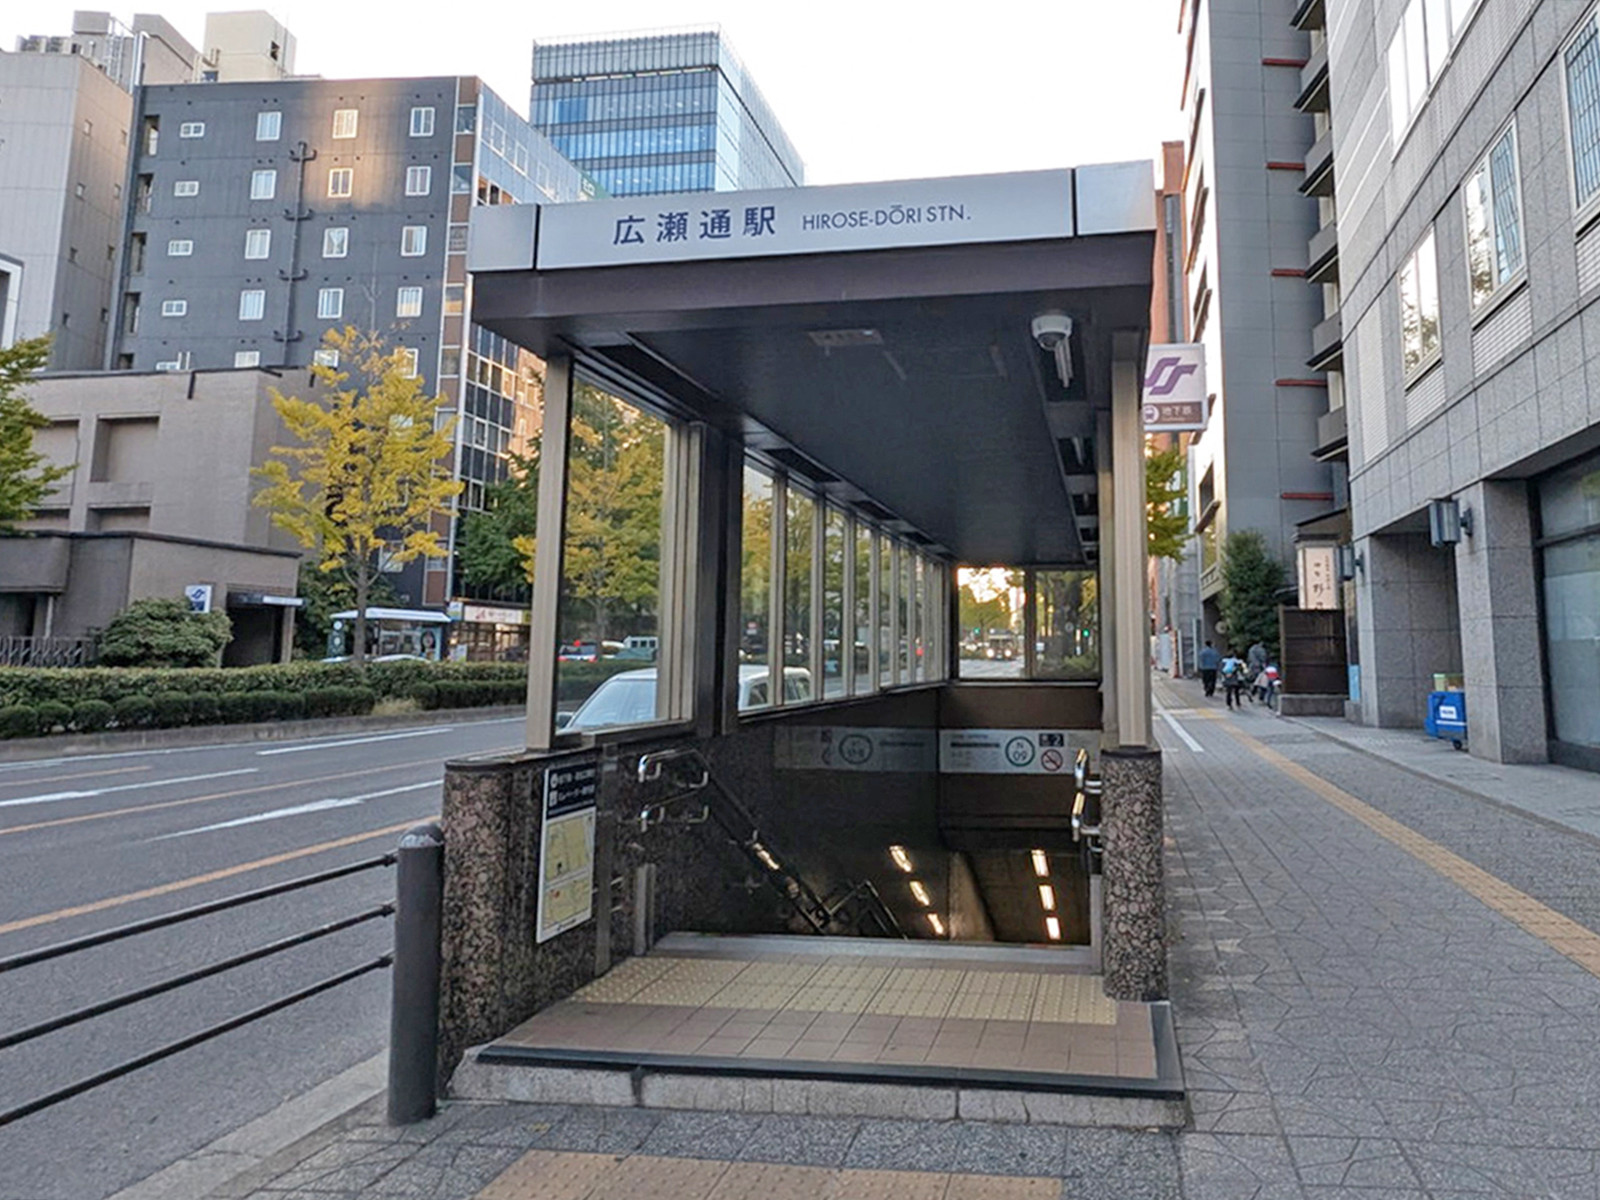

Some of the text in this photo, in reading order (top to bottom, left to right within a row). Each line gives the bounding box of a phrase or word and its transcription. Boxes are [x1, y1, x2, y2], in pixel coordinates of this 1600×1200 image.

[613, 205, 775, 245] 広瀬通駅
[802, 204, 971, 230] HIROSE-DŌRI STN.
